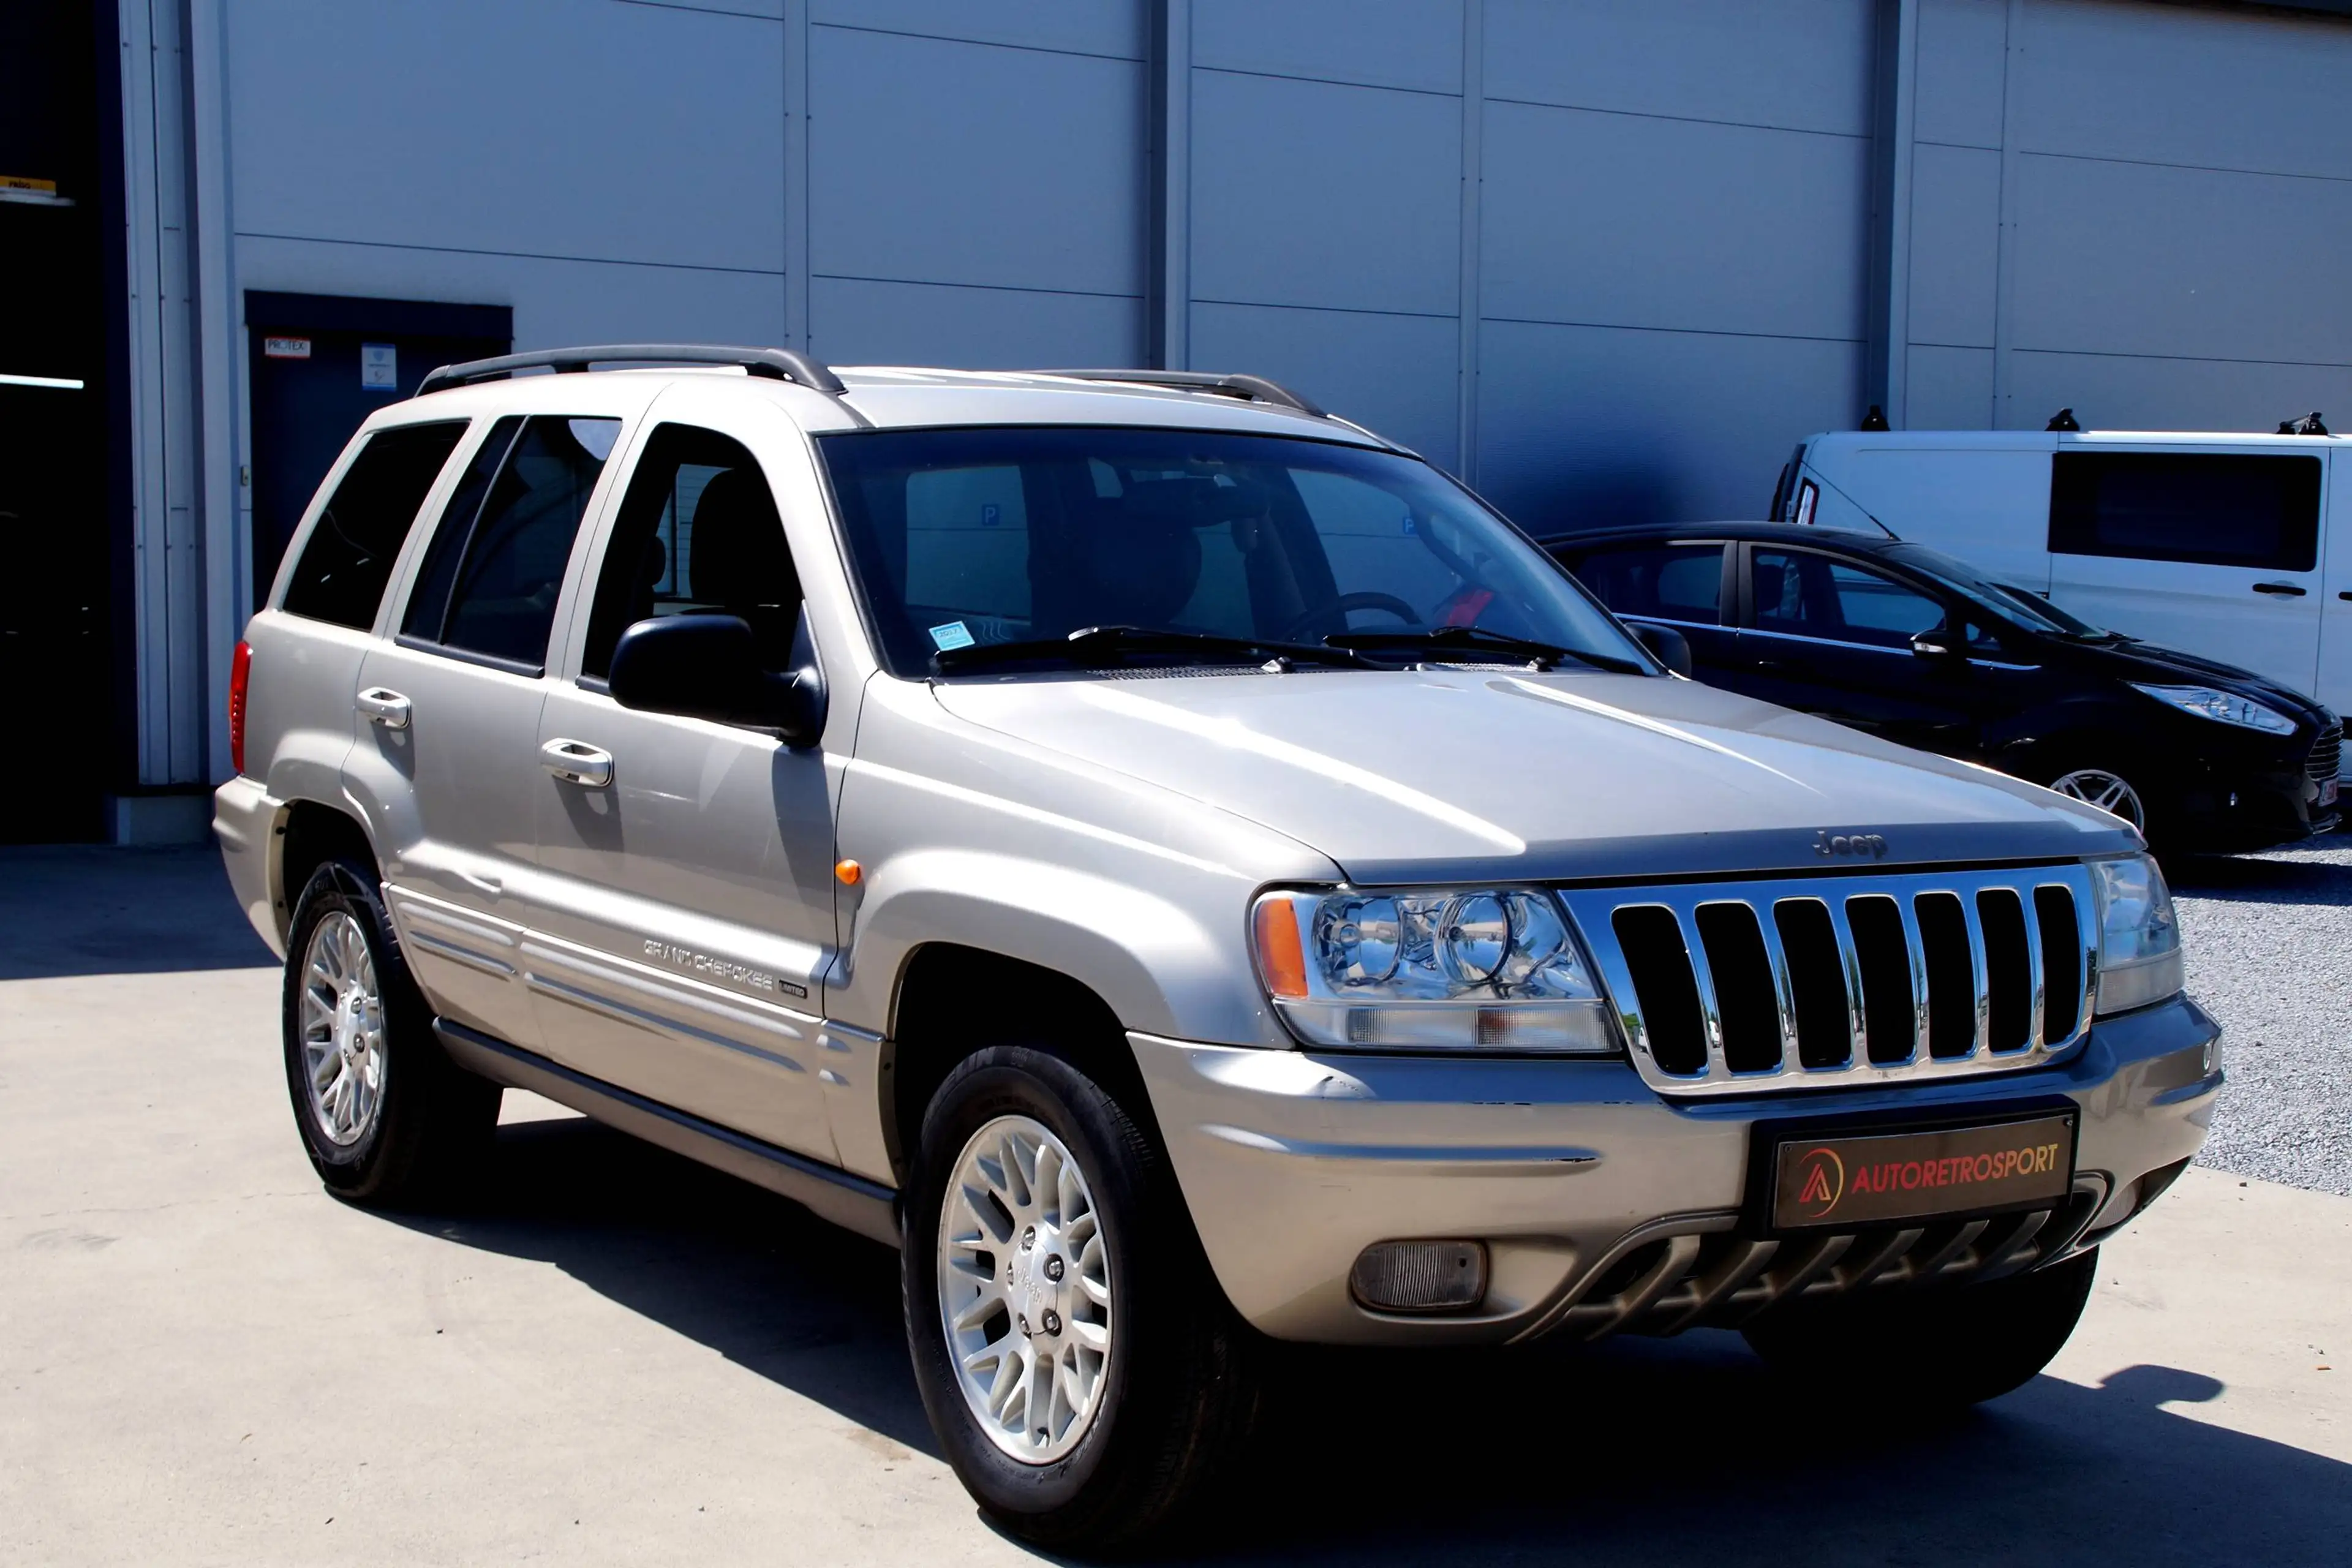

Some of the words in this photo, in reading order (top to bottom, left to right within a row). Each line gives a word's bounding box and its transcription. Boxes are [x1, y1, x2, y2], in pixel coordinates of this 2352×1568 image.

[268, 339, 304, 351] PROTEX
[985, 507, 996, 524] P
[1405, 518, 1414, 533] P
[1812, 829, 1888, 860] Jeep
[644, 940, 692, 967] GRAND
[695, 954, 774, 991] CHEROKEE
[1851, 1144, 2058, 1194] AUTORETROSPORT
